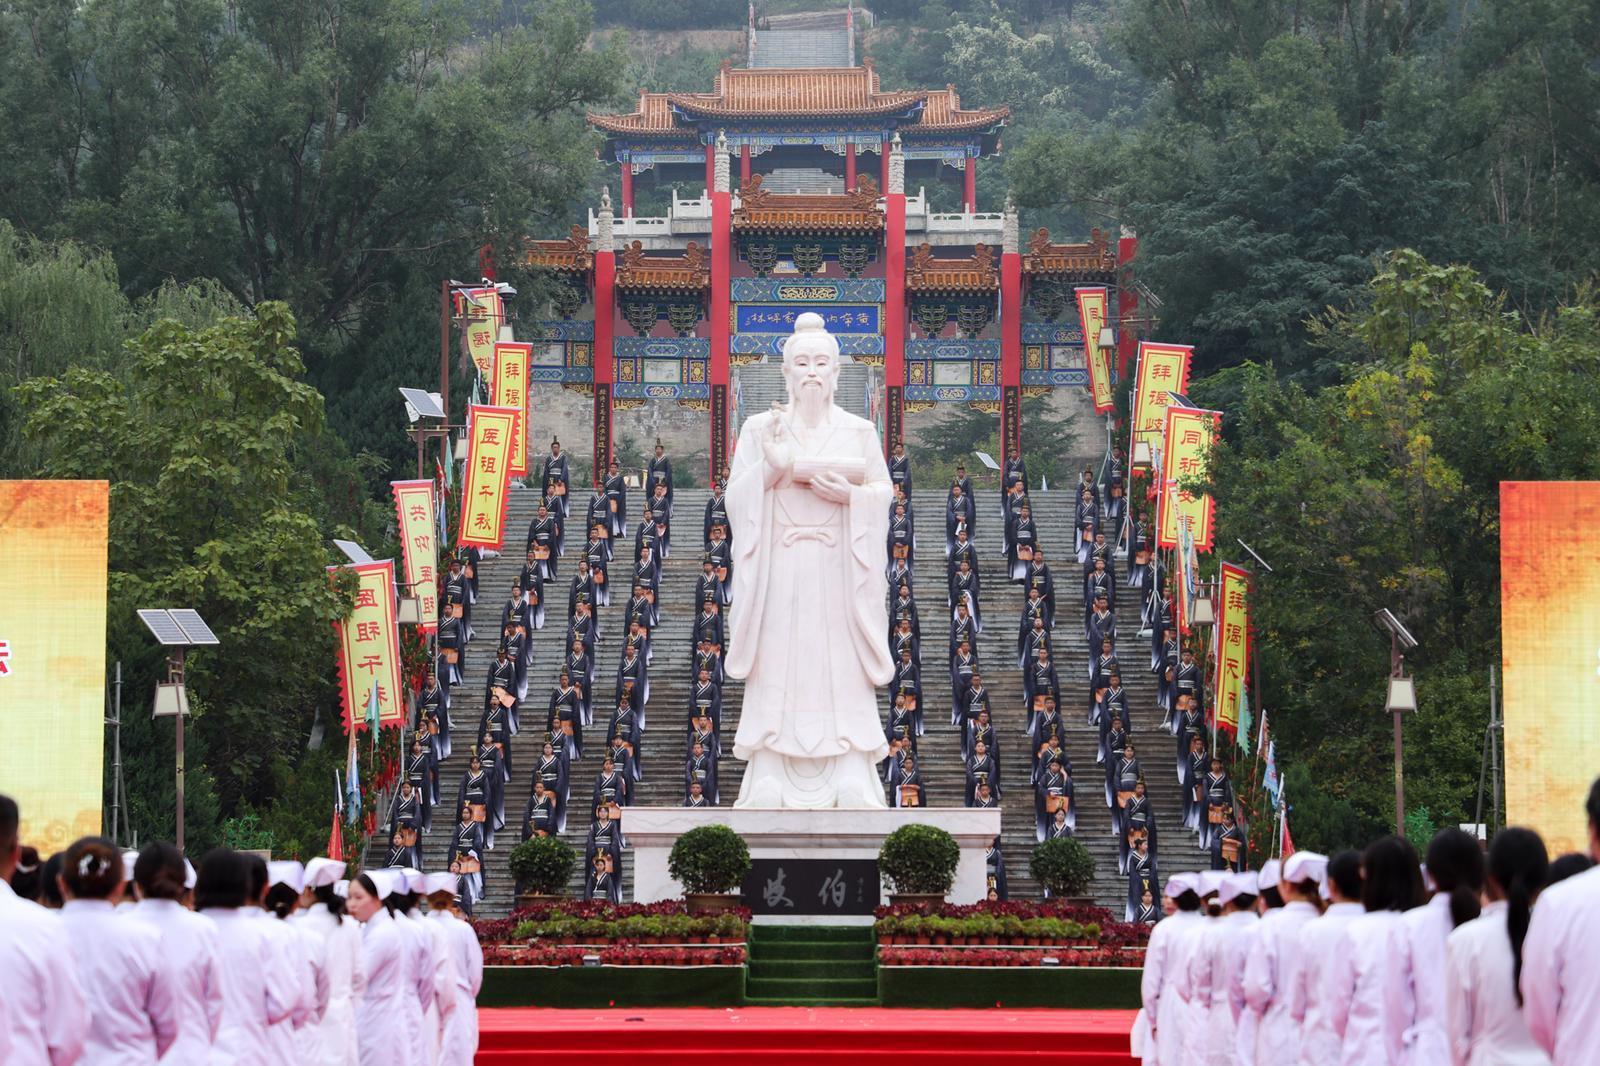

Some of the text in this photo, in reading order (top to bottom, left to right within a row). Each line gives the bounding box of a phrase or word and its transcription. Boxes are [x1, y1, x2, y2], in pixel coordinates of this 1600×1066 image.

[474, 428, 500, 531] 医祖千秋
[763, 867, 846, 908] 岐伯
